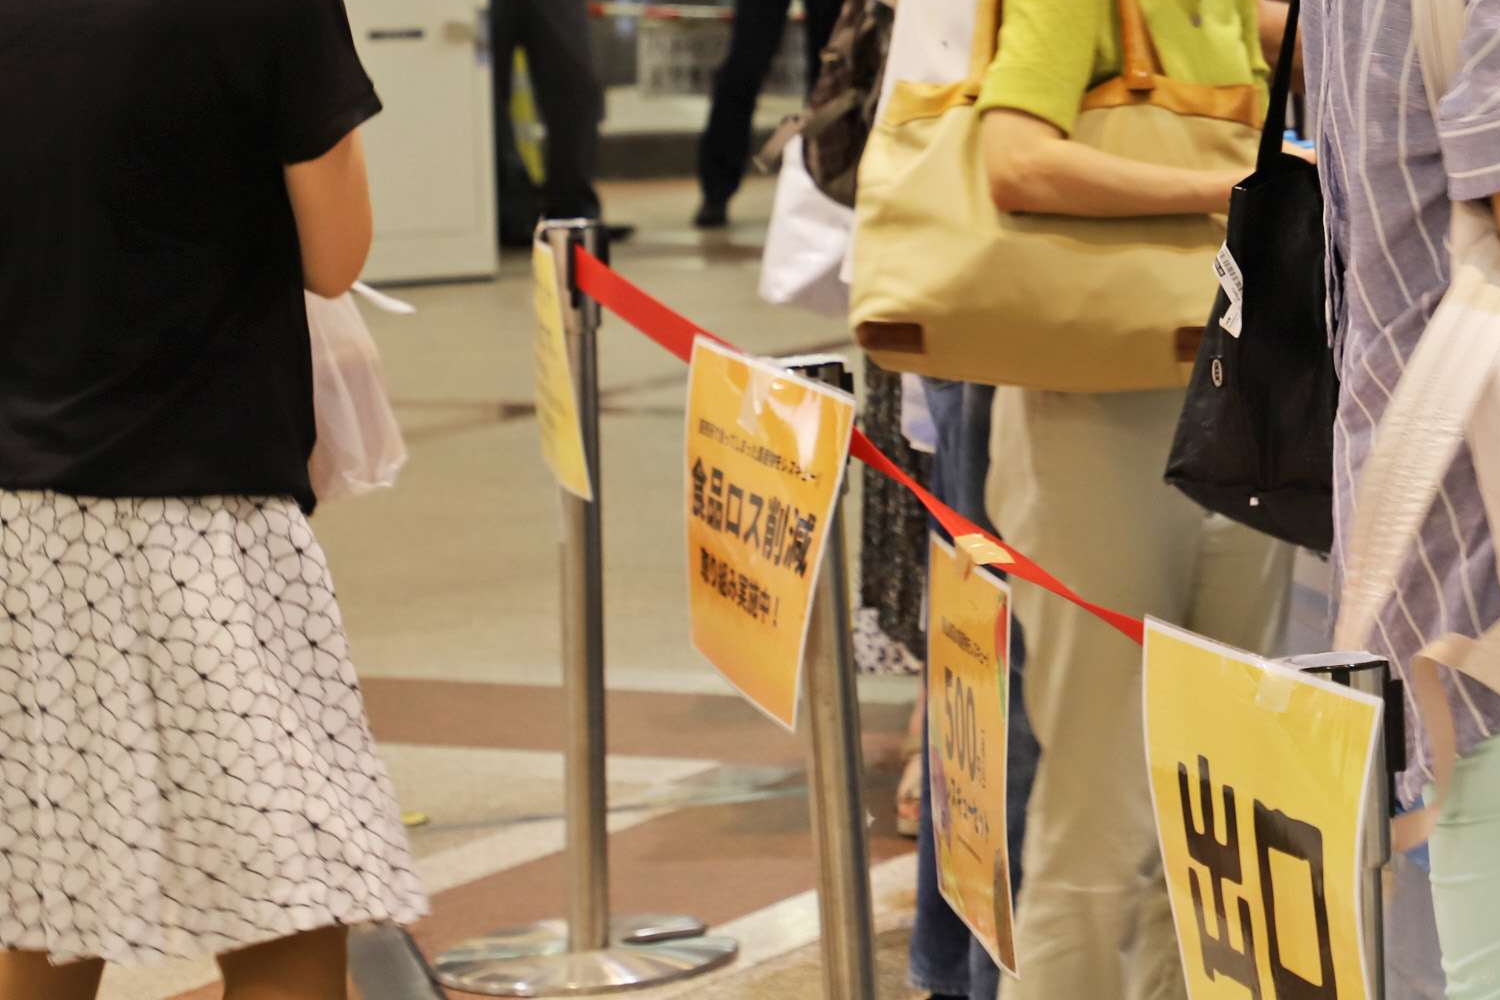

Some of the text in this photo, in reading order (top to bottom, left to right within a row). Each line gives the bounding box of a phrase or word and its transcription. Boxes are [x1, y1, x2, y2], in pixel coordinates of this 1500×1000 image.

[691, 456, 817, 579] 食品ロス削減
[1177, 754, 1338, 1000] 出口
